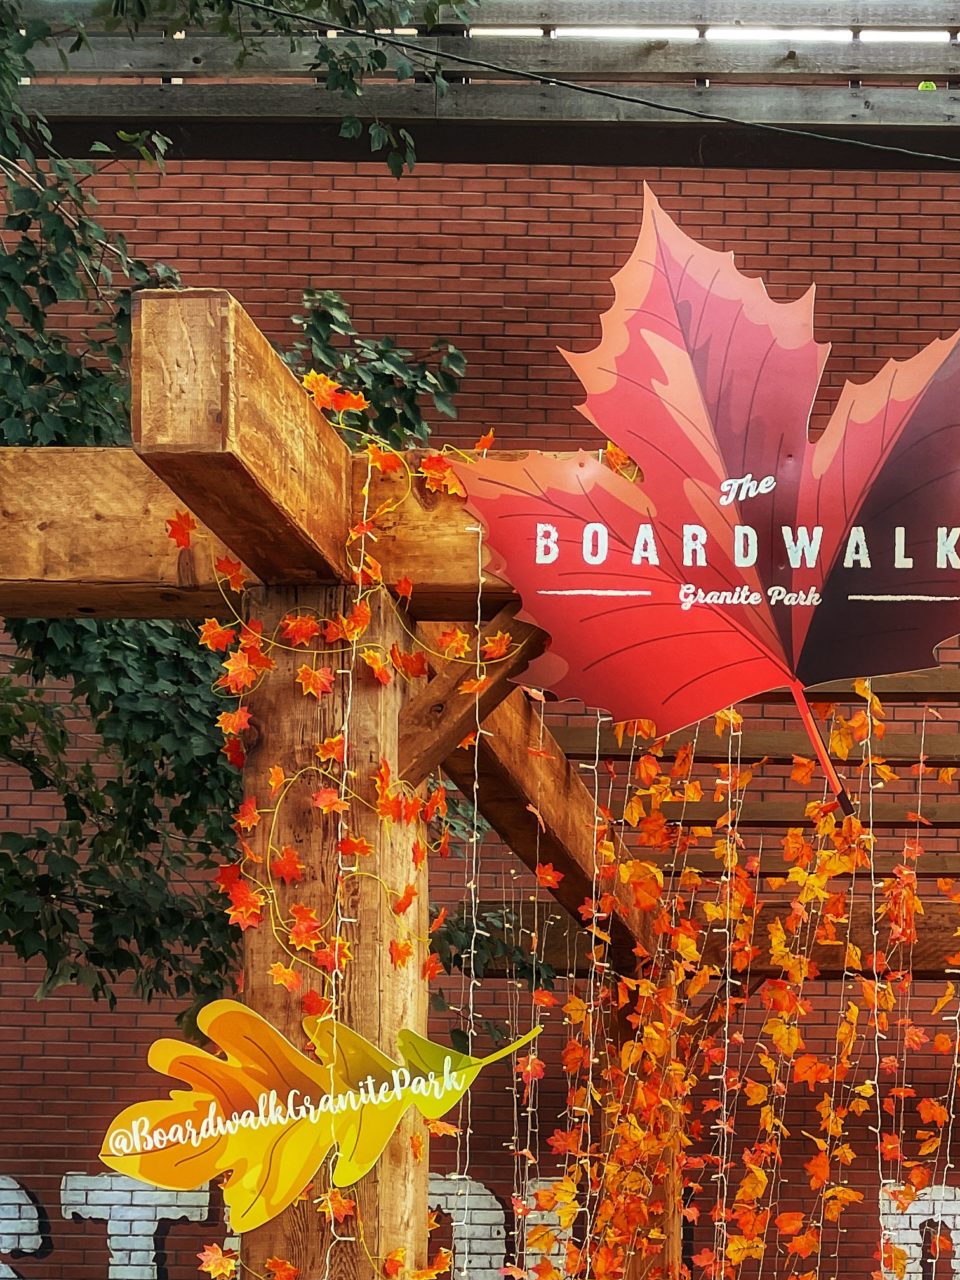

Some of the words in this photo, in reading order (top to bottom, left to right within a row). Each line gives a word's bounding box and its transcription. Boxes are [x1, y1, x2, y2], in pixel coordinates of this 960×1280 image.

[719, 473, 777, 506] The
[678, 582, 763, 611] Granite
[767, 585, 823, 607] Park
[108, 1055, 466, 1157] @BoardwalkGranitePark
